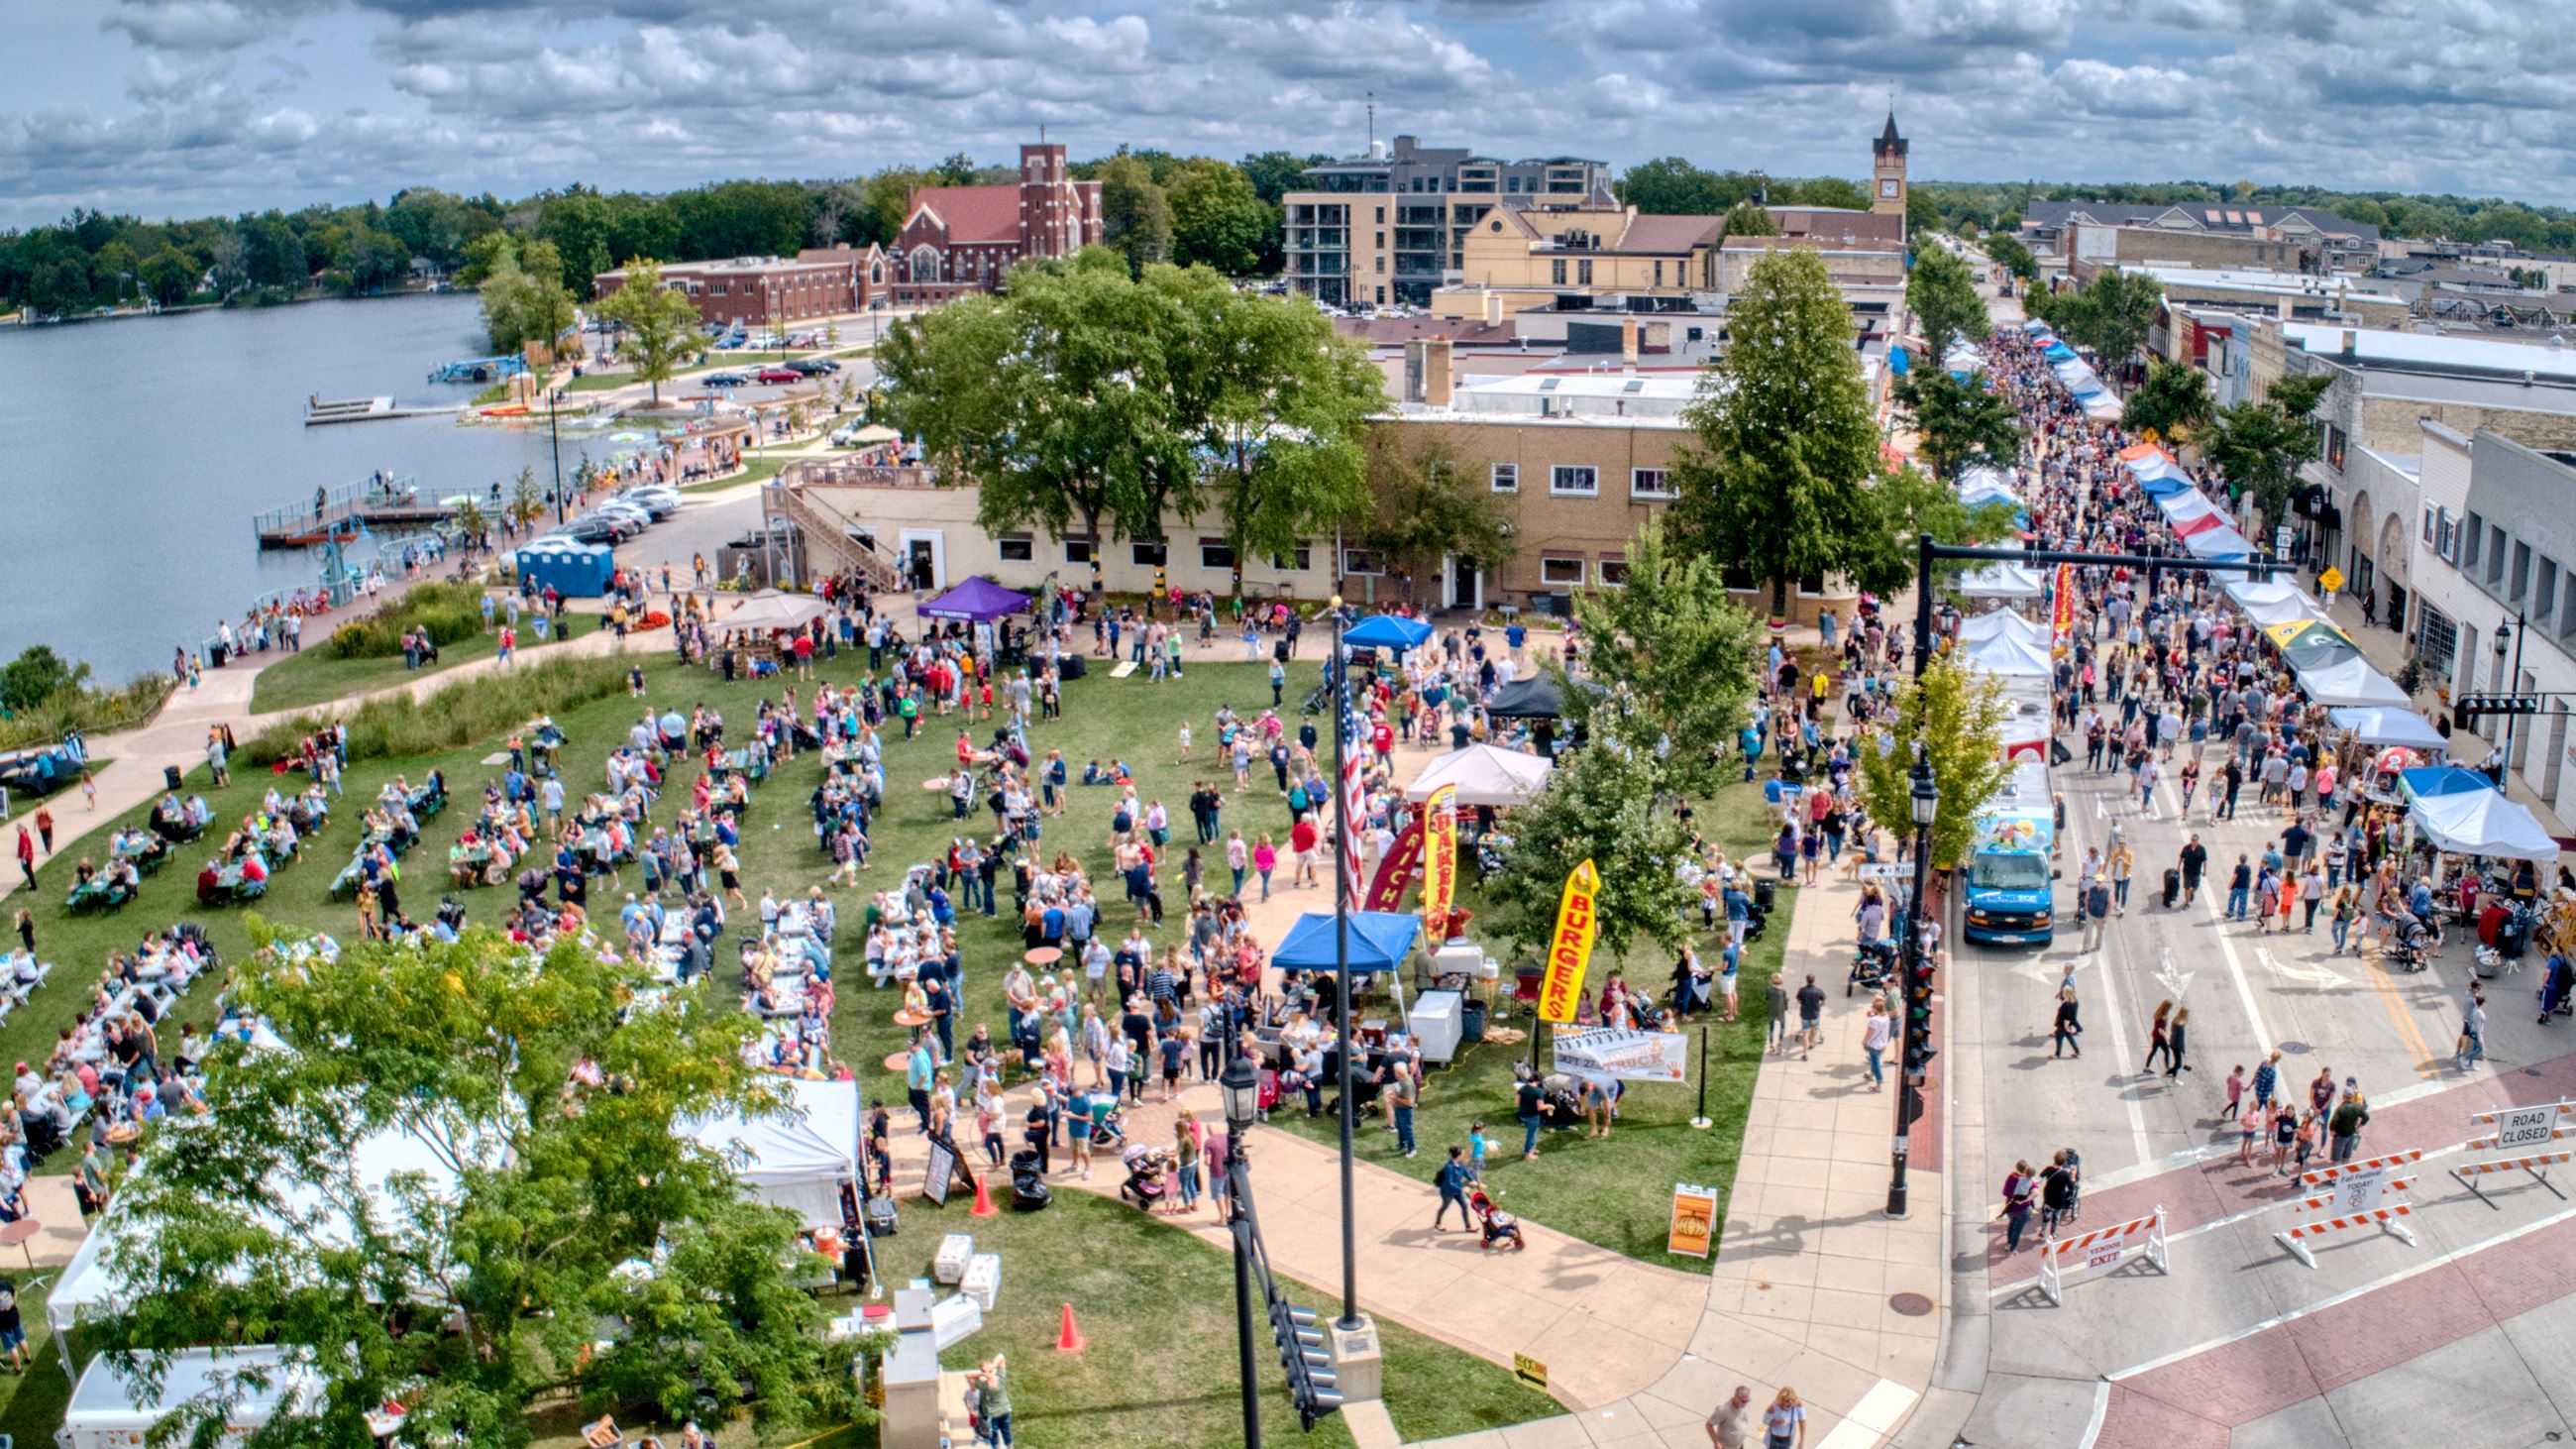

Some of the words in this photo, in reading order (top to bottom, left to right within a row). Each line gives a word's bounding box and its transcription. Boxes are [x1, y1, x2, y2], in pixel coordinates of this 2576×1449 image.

[2279, 536, 2289, 545] 16
[1548, 894, 1590, 1020] BURGERS
[1601, 1053, 1665, 1073] TRUCK
[2512, 1112, 2545, 1127] ROAD
[2502, 1126, 2548, 1143] CLOSED
[2340, 1173, 2355, 1183] Fall
[2355, 1169, 2383, 1179] Festival
[2090, 1241, 2121, 1255] VENDOR
[2090, 1251, 2119, 1268] EXIT
